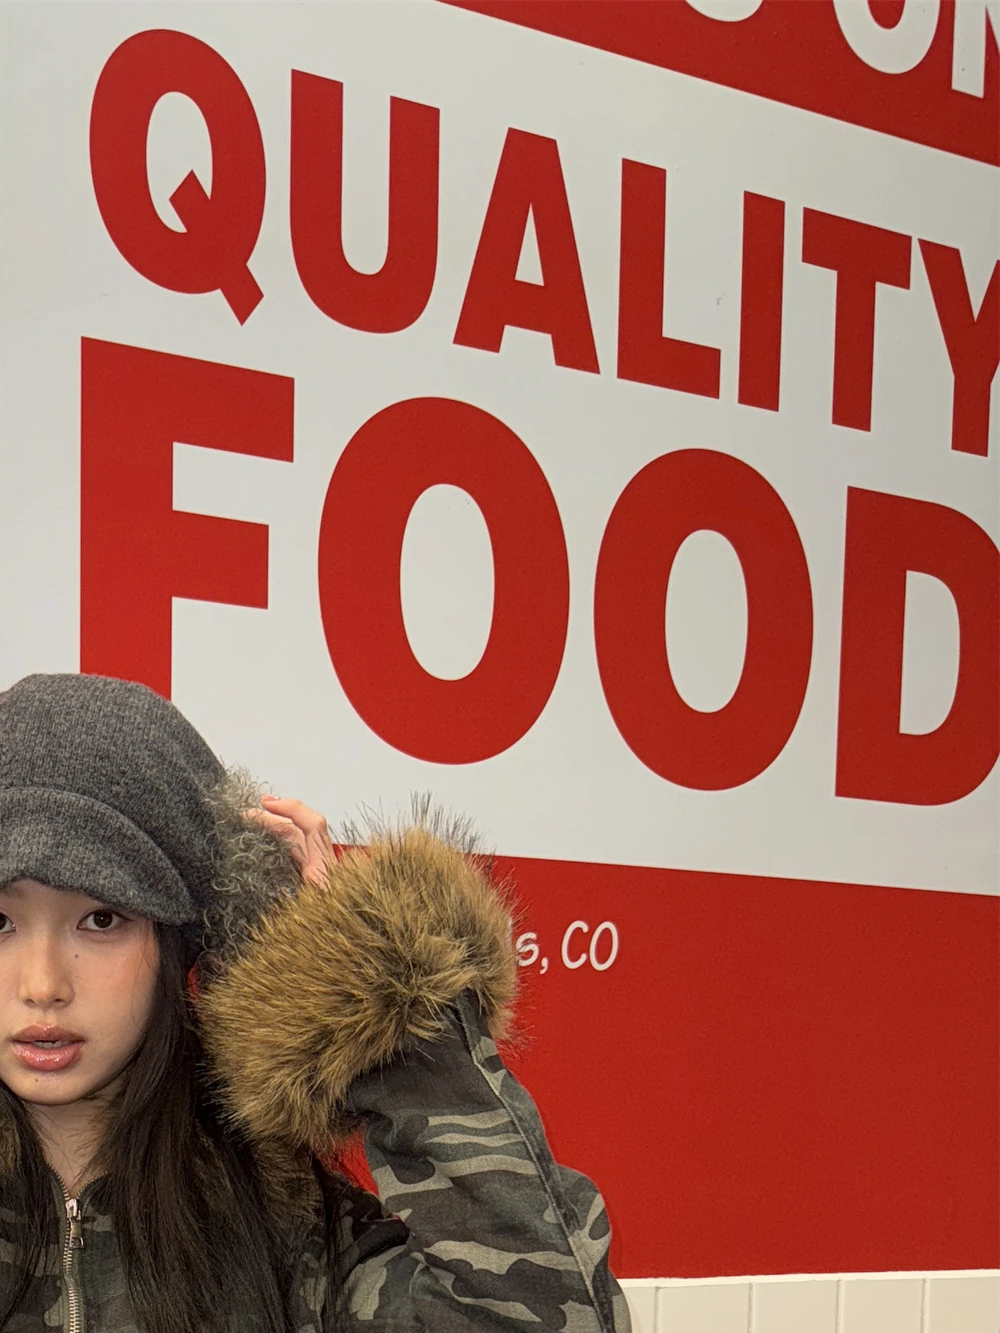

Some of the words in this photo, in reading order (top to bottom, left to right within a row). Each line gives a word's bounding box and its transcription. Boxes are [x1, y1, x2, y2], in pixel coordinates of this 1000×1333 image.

[89, 28, 1000, 457] QUALITY
[80, 336, 1000, 806] FOOD
[561, 920, 619, 971] CO
